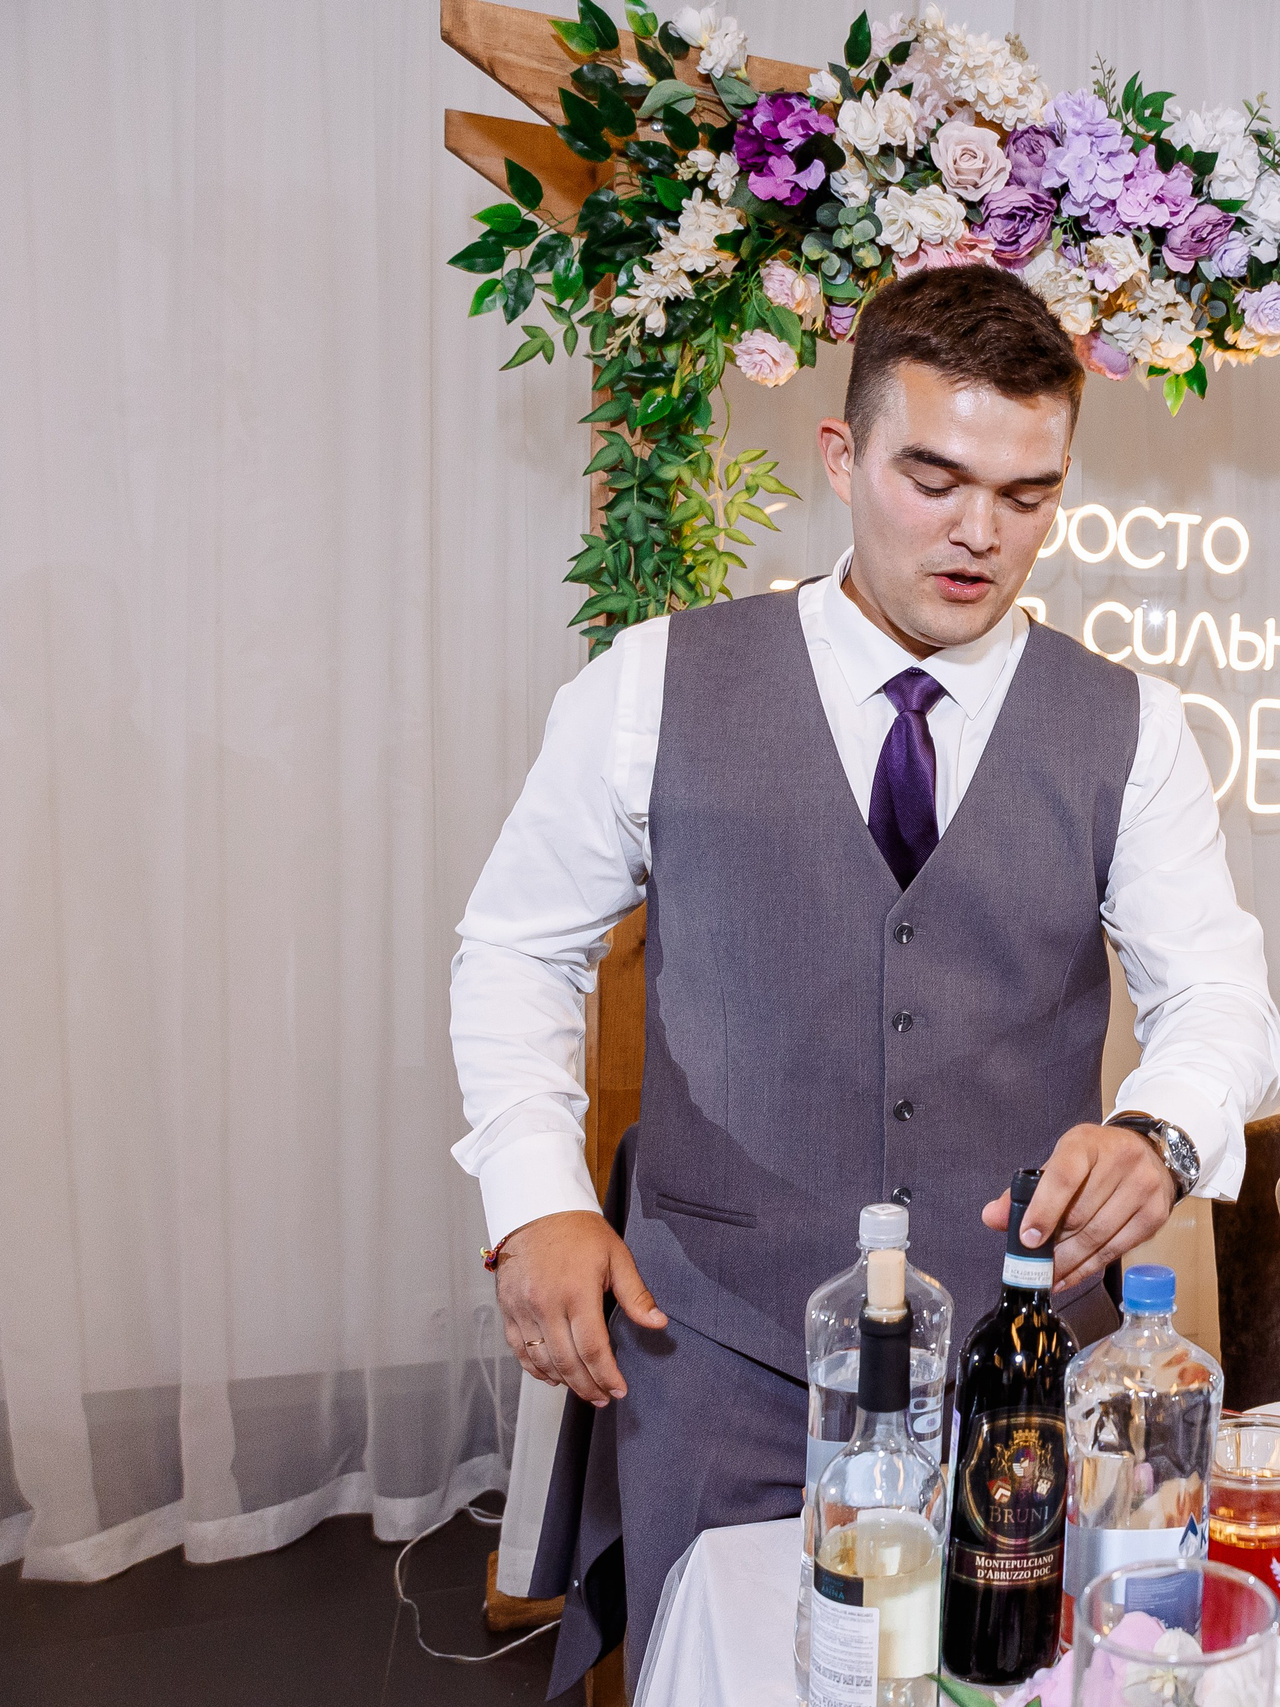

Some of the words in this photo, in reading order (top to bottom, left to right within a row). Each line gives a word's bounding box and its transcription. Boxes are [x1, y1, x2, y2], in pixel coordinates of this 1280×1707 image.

[989, 1505, 1049, 1524] BRUNI
[975, 1554, 1054, 1569] MONTEPULCIANO
[977, 1568, 1031, 1580] D'ABRUZZO
[1033, 1565, 1051, 1578] DOC
